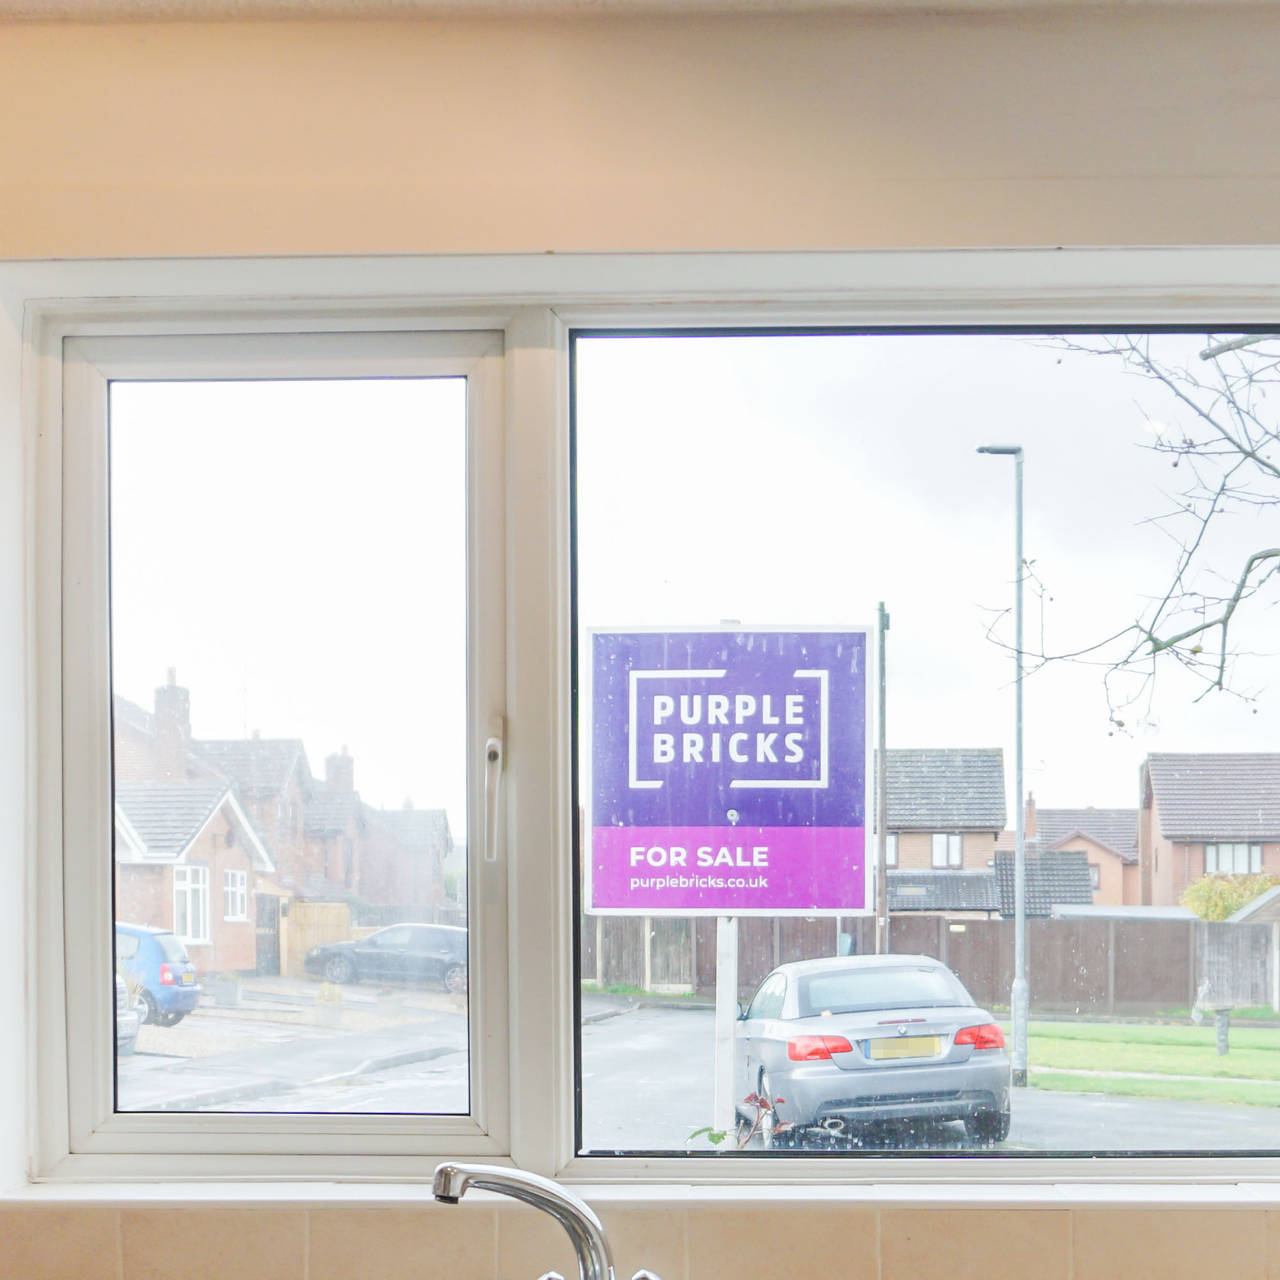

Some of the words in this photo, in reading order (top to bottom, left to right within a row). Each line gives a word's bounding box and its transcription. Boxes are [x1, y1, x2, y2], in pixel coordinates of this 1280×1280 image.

[653, 695, 804, 725] PURPLE
[653, 732, 804, 763] BRICKS
[630, 846, 687, 867] FOR
[696, 846, 769, 867] SALE
[630, 874, 768, 890] purplebricks.co.uk
